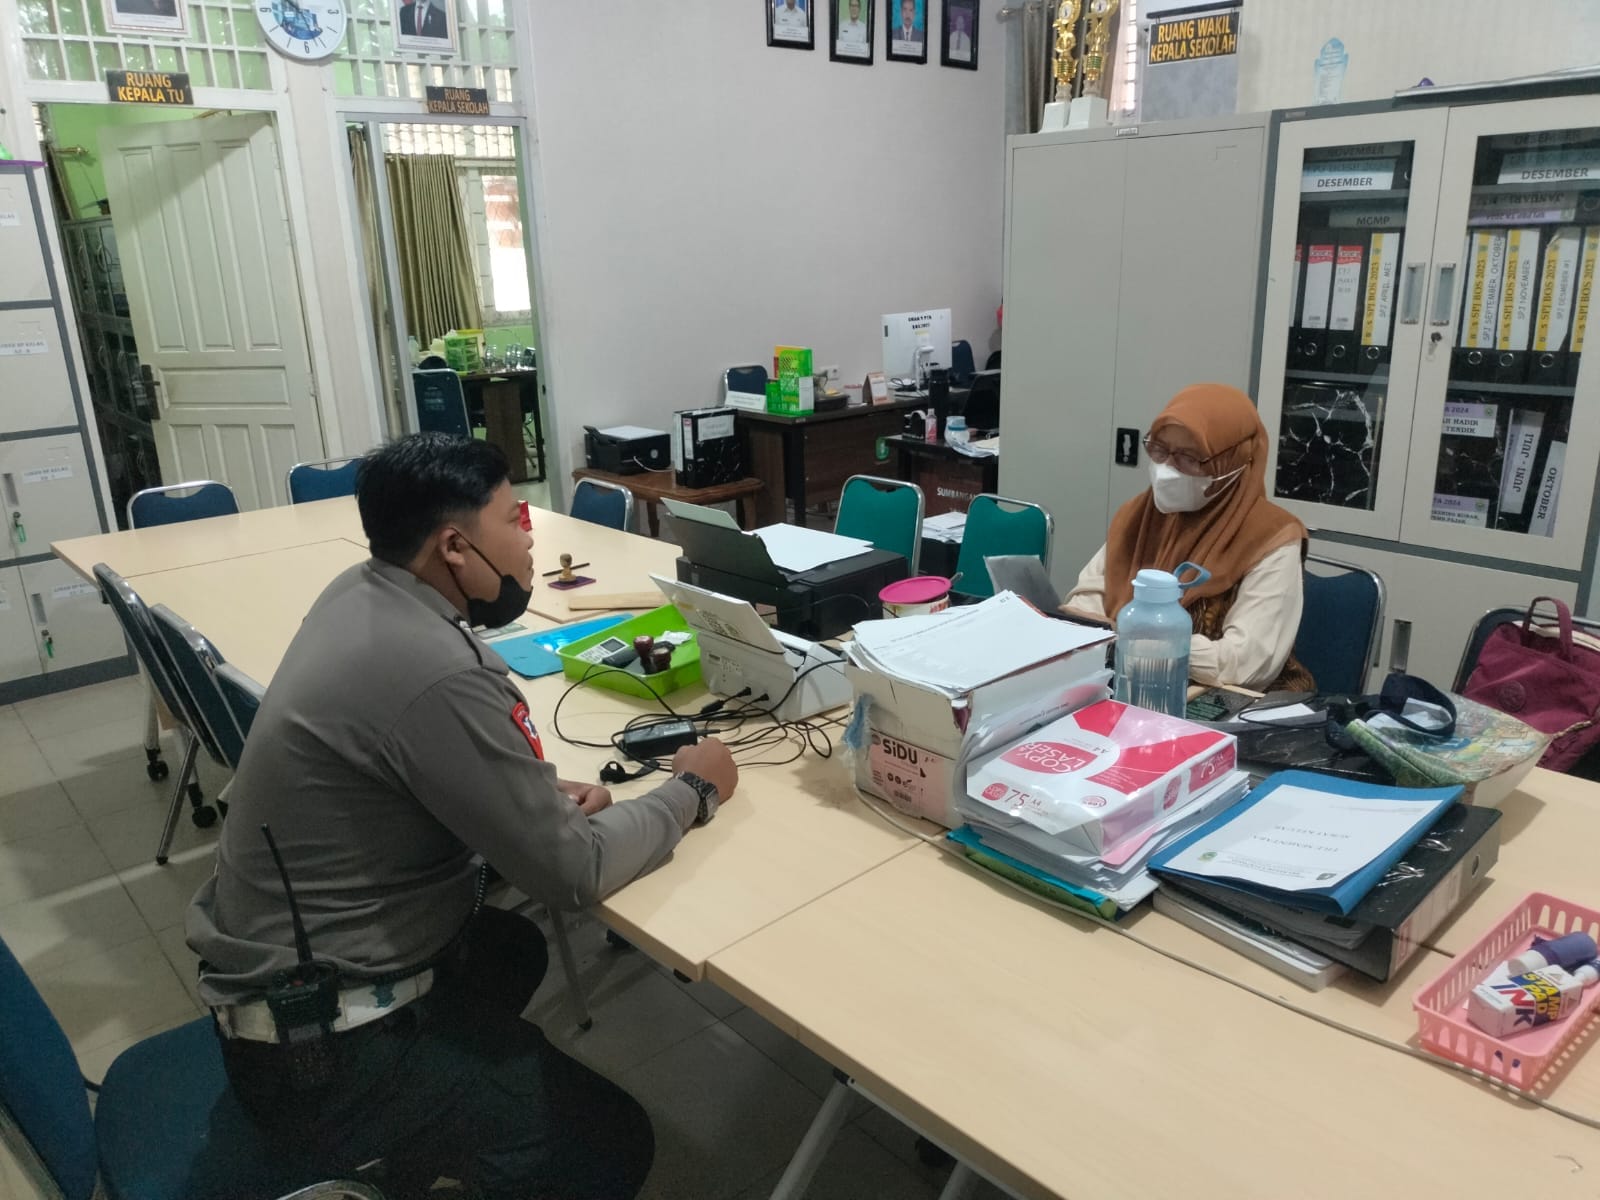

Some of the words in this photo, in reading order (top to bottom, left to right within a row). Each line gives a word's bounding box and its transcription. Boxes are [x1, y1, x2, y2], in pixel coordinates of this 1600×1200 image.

[1158, 21, 1195, 43] RUANG
[1197, 16, 1231, 37] WAKIL
[1151, 42, 1187, 62] KEPALA
[1189, 35, 1237, 55] SEKOLAH
[126, 72, 172, 87] RUANG
[118, 87, 165, 103] KEPALA
[169, 90, 184, 103] TU
[444, 88, 471, 101] RUANG
[428, 100, 456, 113] KEPALA
[457, 102, 489, 114] SEKOLAH
[1317, 177, 1373, 187] DESEMBER
[1521, 167, 1589, 180] DESEMBER
[1356, 215, 1390, 225] MGMP
[1453, 418, 1479, 426] HADIR
[1511, 468, 1526, 494] JUNI
[1520, 432, 1535, 459] JULI
[1536, 467, 1558, 521] OKTOBER
[882, 738, 918, 764] SiDU
[1016, 748, 1072, 773] COPY
[1023, 742, 1087, 768] LASER
[1200, 756, 1215, 779] 75
[1004, 789, 1030, 806] 75
[1490, 984, 1536, 1027] INK
[1522, 973, 1561, 1020] STAMP
[1522, 984, 1547, 1015] PAD
